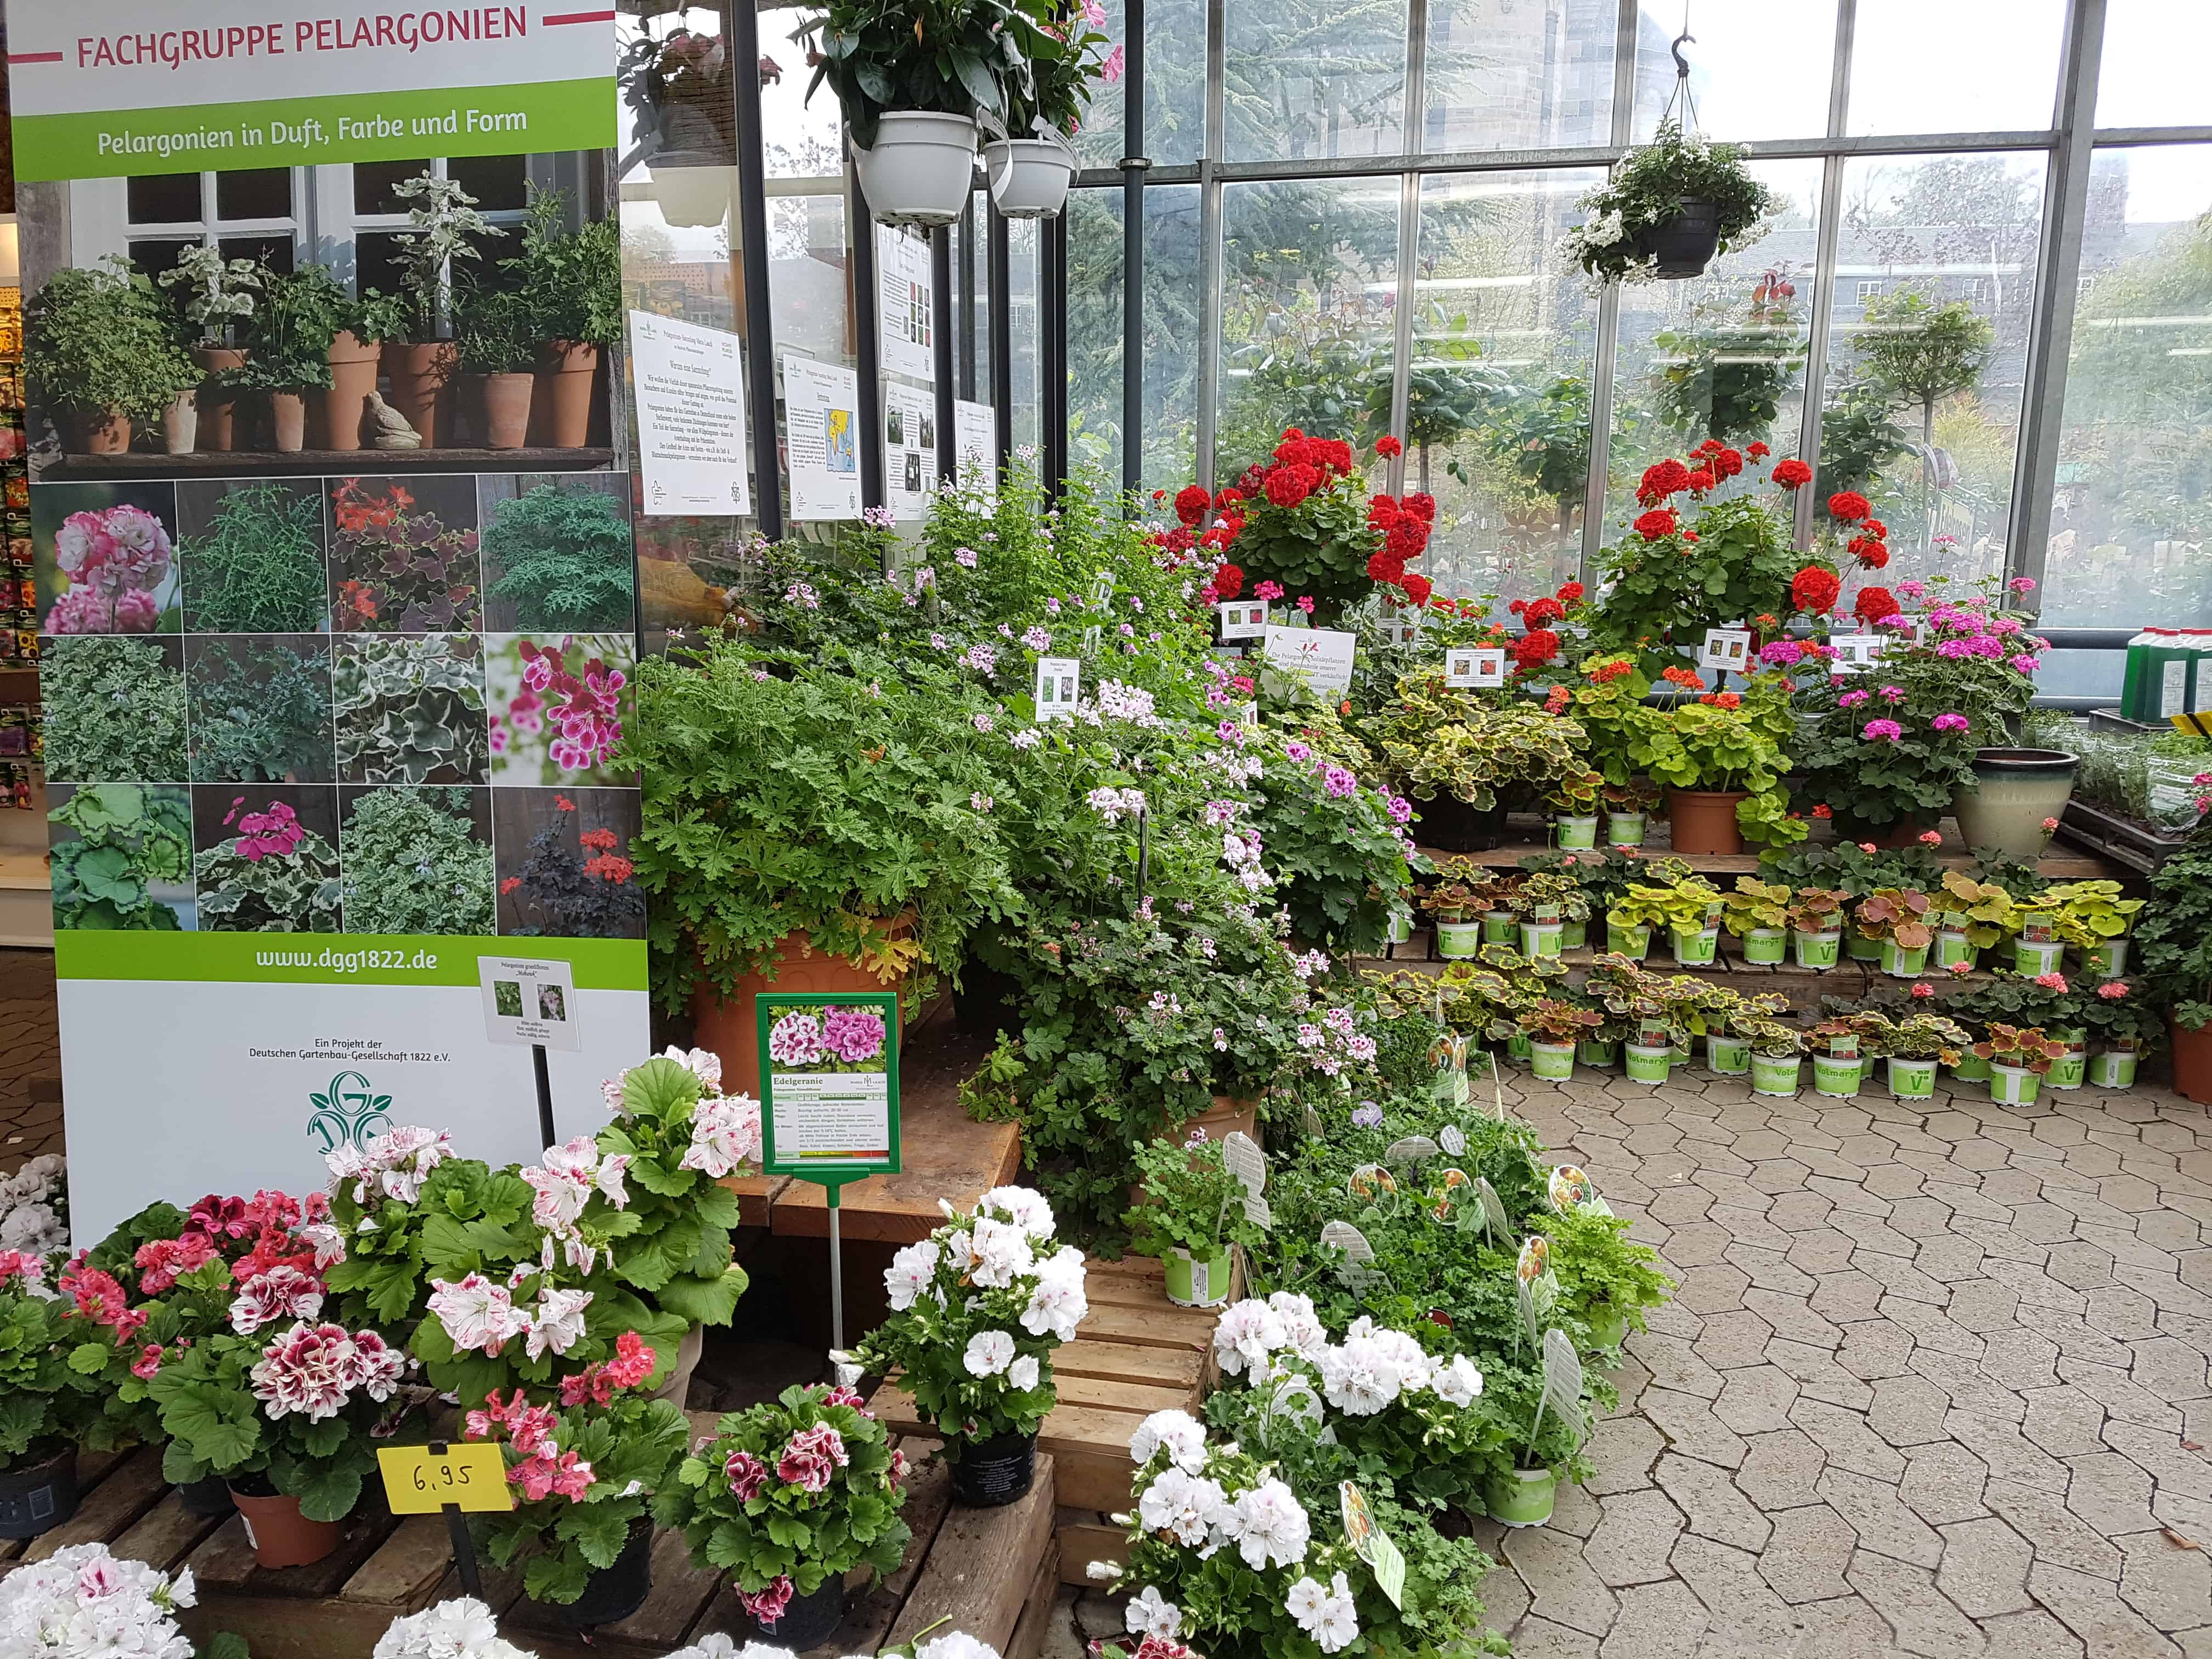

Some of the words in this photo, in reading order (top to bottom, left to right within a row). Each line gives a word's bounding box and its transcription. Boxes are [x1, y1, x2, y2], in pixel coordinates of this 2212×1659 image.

[77, 22, 284, 71] FACHGRUPPE
[296, 6, 527, 56] PELARGONIEN
[98, 127, 234, 158] Pelargonien
[241, 127, 264, 147] in
[271, 119, 330, 149] Duft,
[338, 117, 404, 141] Farbe
[413, 112, 457, 136] und
[466, 110, 527, 133] Form
[256, 948, 437, 974] www.dgg1822.de
[315, 1039, 329, 1048] Ein
[332, 1039, 364, 1050] Projekt
[368, 1040, 382, 1049] der
[250, 1049, 296, 1059] Deutschen
[299, 1049, 408, 1063] Gartenbau-Gesellschaft
[410, 1053, 431, 1061] 1822
[433, 1053, 451, 1062] e.V.
[1628, 1053, 1664, 1066] Volmary
[1818, 1067, 1854, 1079] Volmary
[774, 1077, 823, 1086] Edelgeranie
[413, 1465, 473, 1491] 6,95
